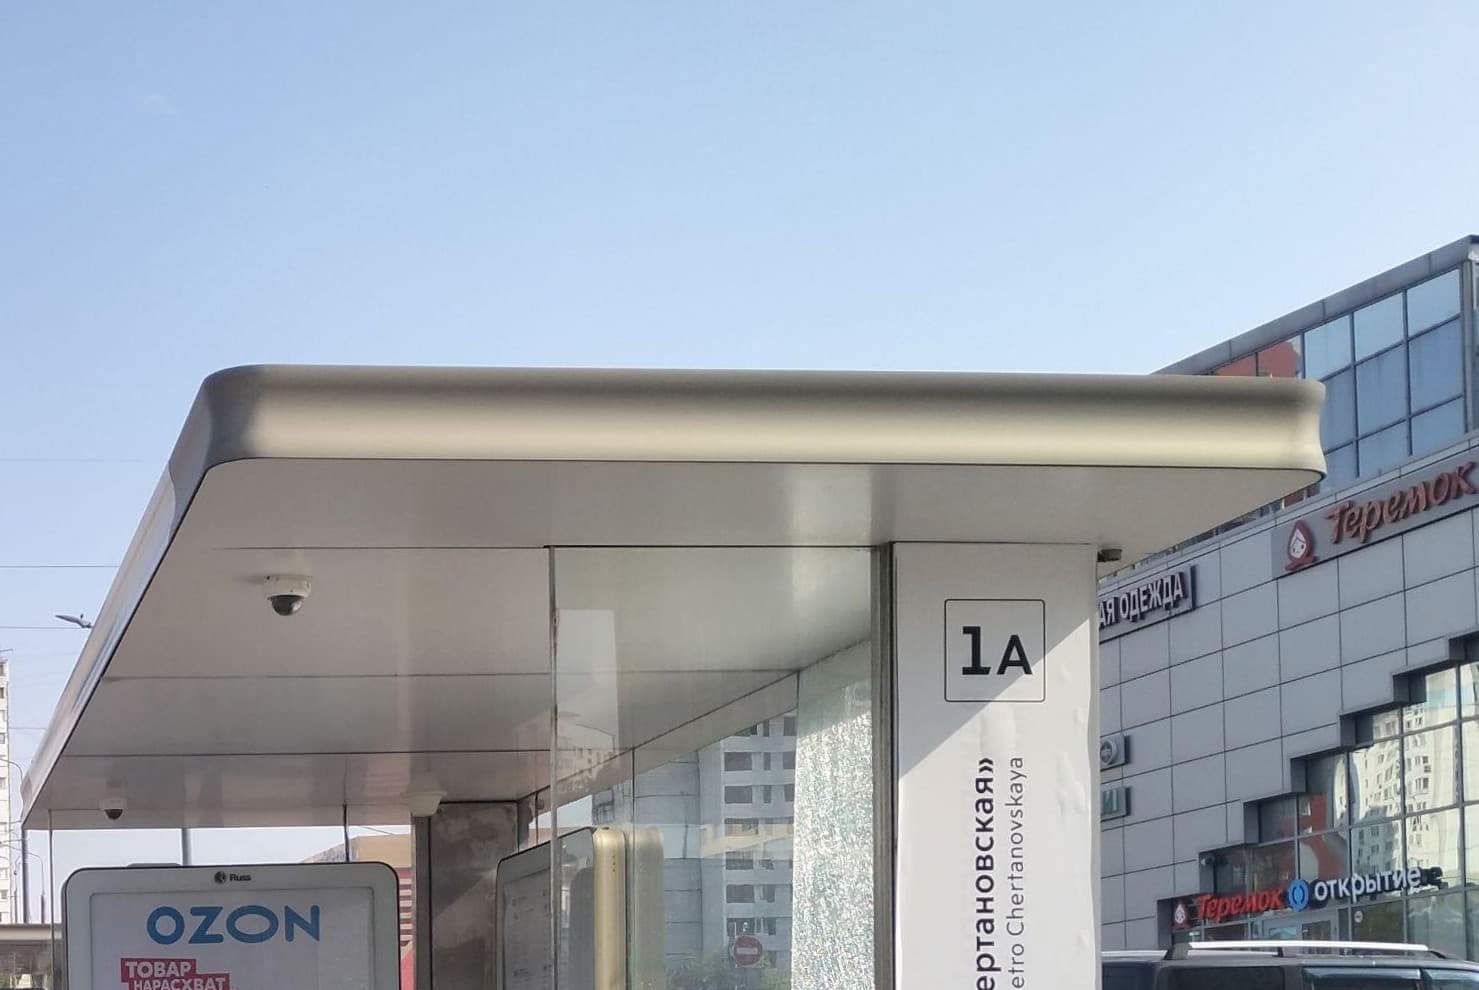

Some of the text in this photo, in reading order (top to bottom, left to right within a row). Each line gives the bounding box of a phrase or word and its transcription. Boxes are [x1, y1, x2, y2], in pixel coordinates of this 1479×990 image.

[1325, 462, 1478, 544] Теремок
[1120, 573, 1184, 621] ОДЕЖДА
[1005, 757, 1028, 936] Chertanovskaya
[229, 872, 252, 882] Russ
[1314, 867, 1421, 901] открытие
[1195, 887, 1284, 921] Теремок
[146, 905, 320, 945] OZON
[125, 961, 192, 979] ТОВАР
